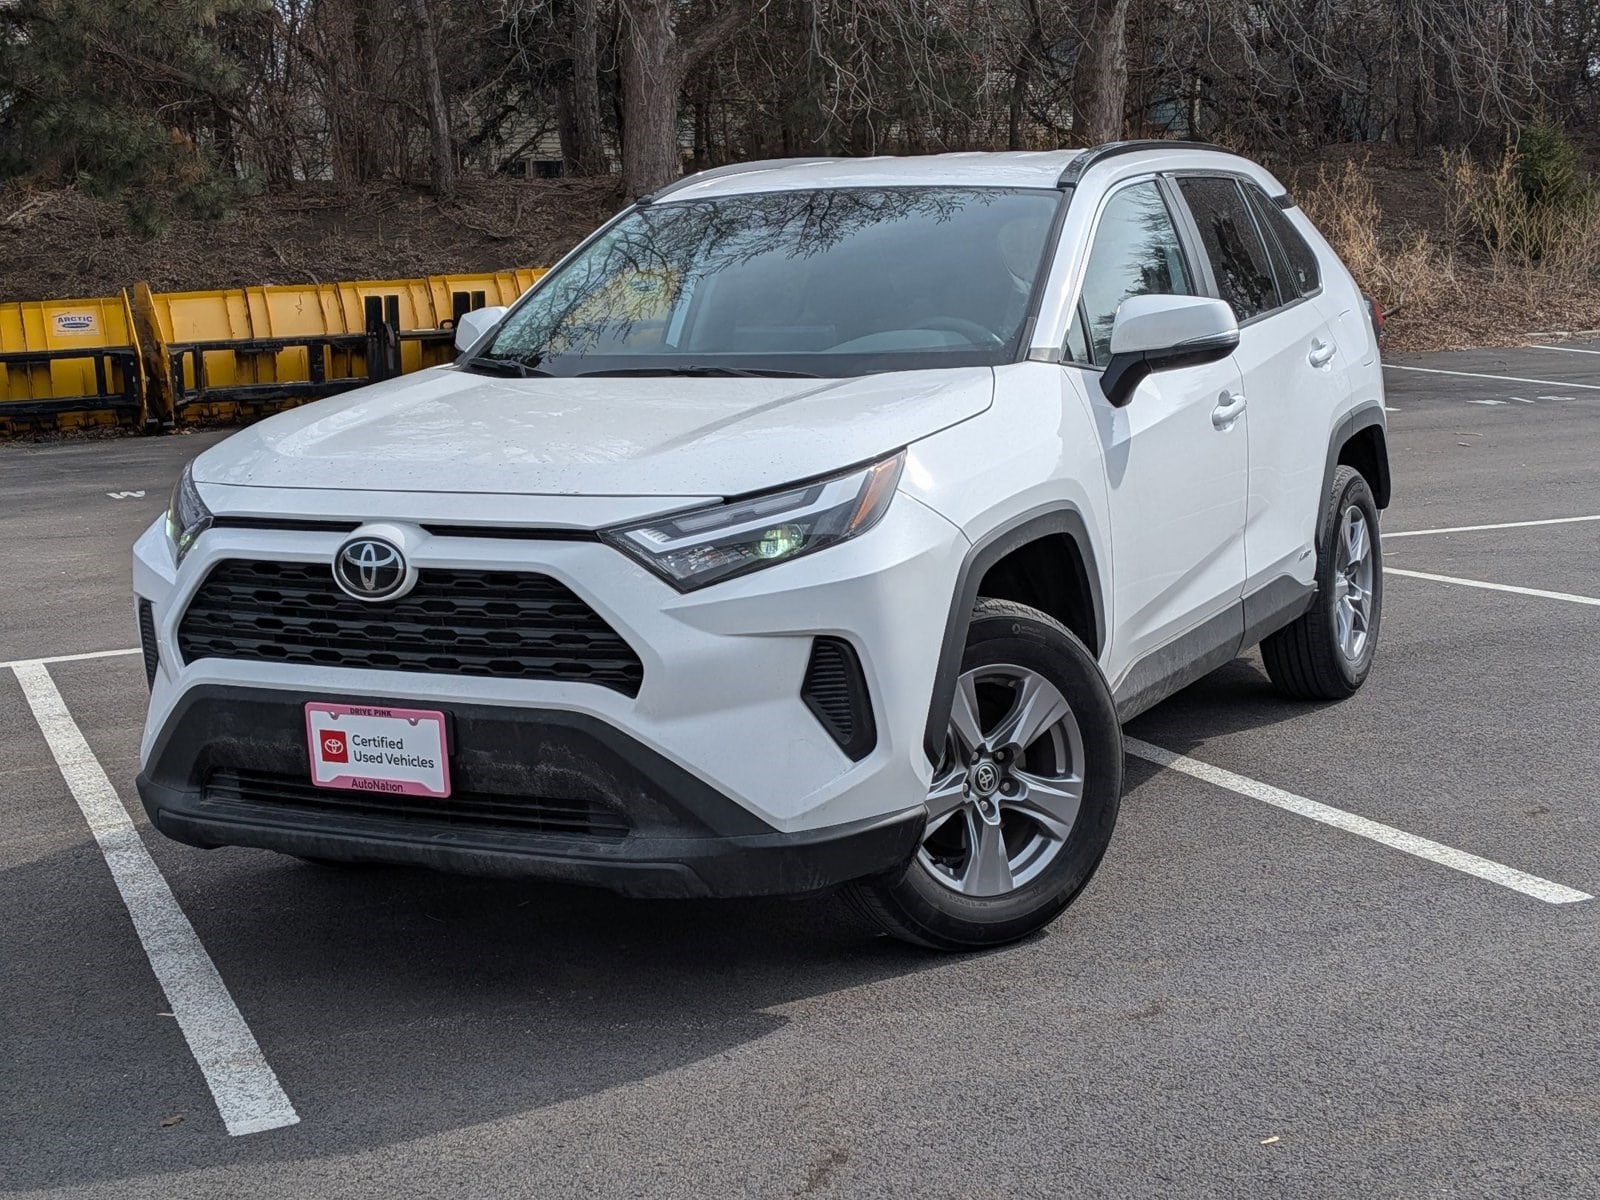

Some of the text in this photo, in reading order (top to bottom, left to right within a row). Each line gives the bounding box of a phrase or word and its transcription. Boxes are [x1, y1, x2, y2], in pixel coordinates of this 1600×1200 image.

[350, 708, 392, 717] DRIVE PINK
[352, 734, 403, 749] Certified
[353, 750, 434, 768] Used Vehicles
